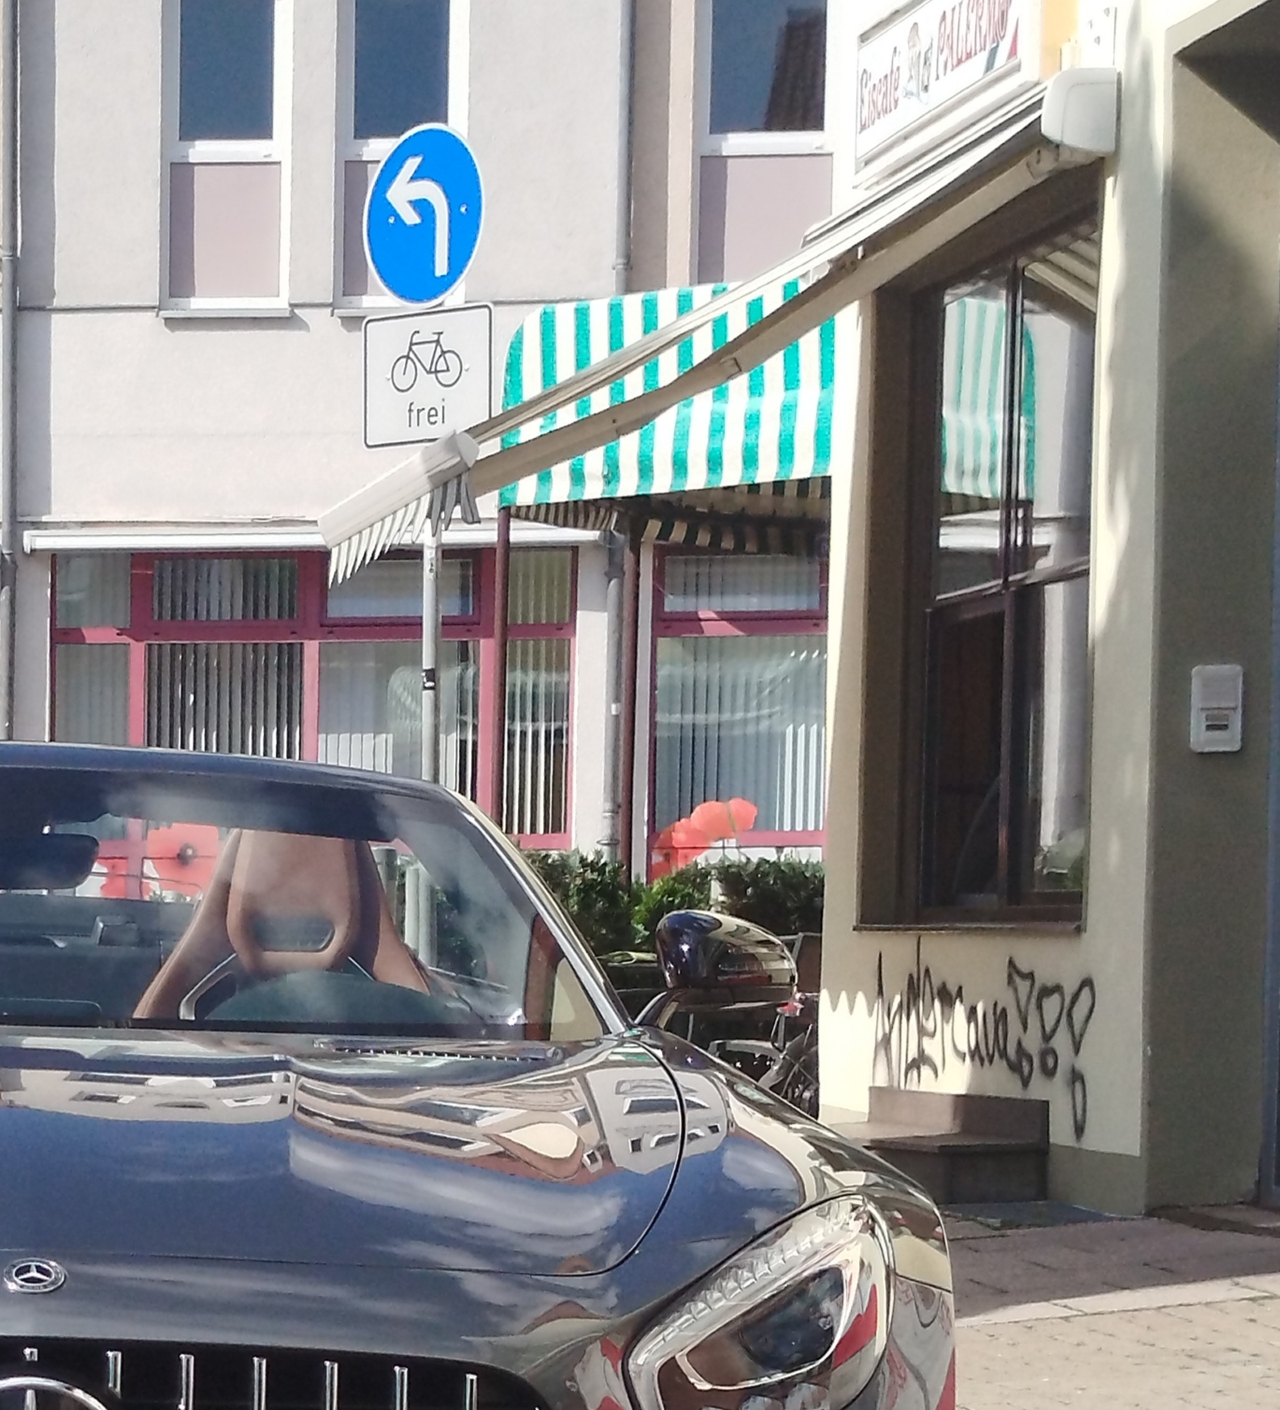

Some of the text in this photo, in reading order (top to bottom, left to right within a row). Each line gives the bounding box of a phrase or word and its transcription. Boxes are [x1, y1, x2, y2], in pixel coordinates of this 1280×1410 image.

[858, 0, 1012, 134] Eiscafé PALERMO
[407, 397, 446, 428] frei
